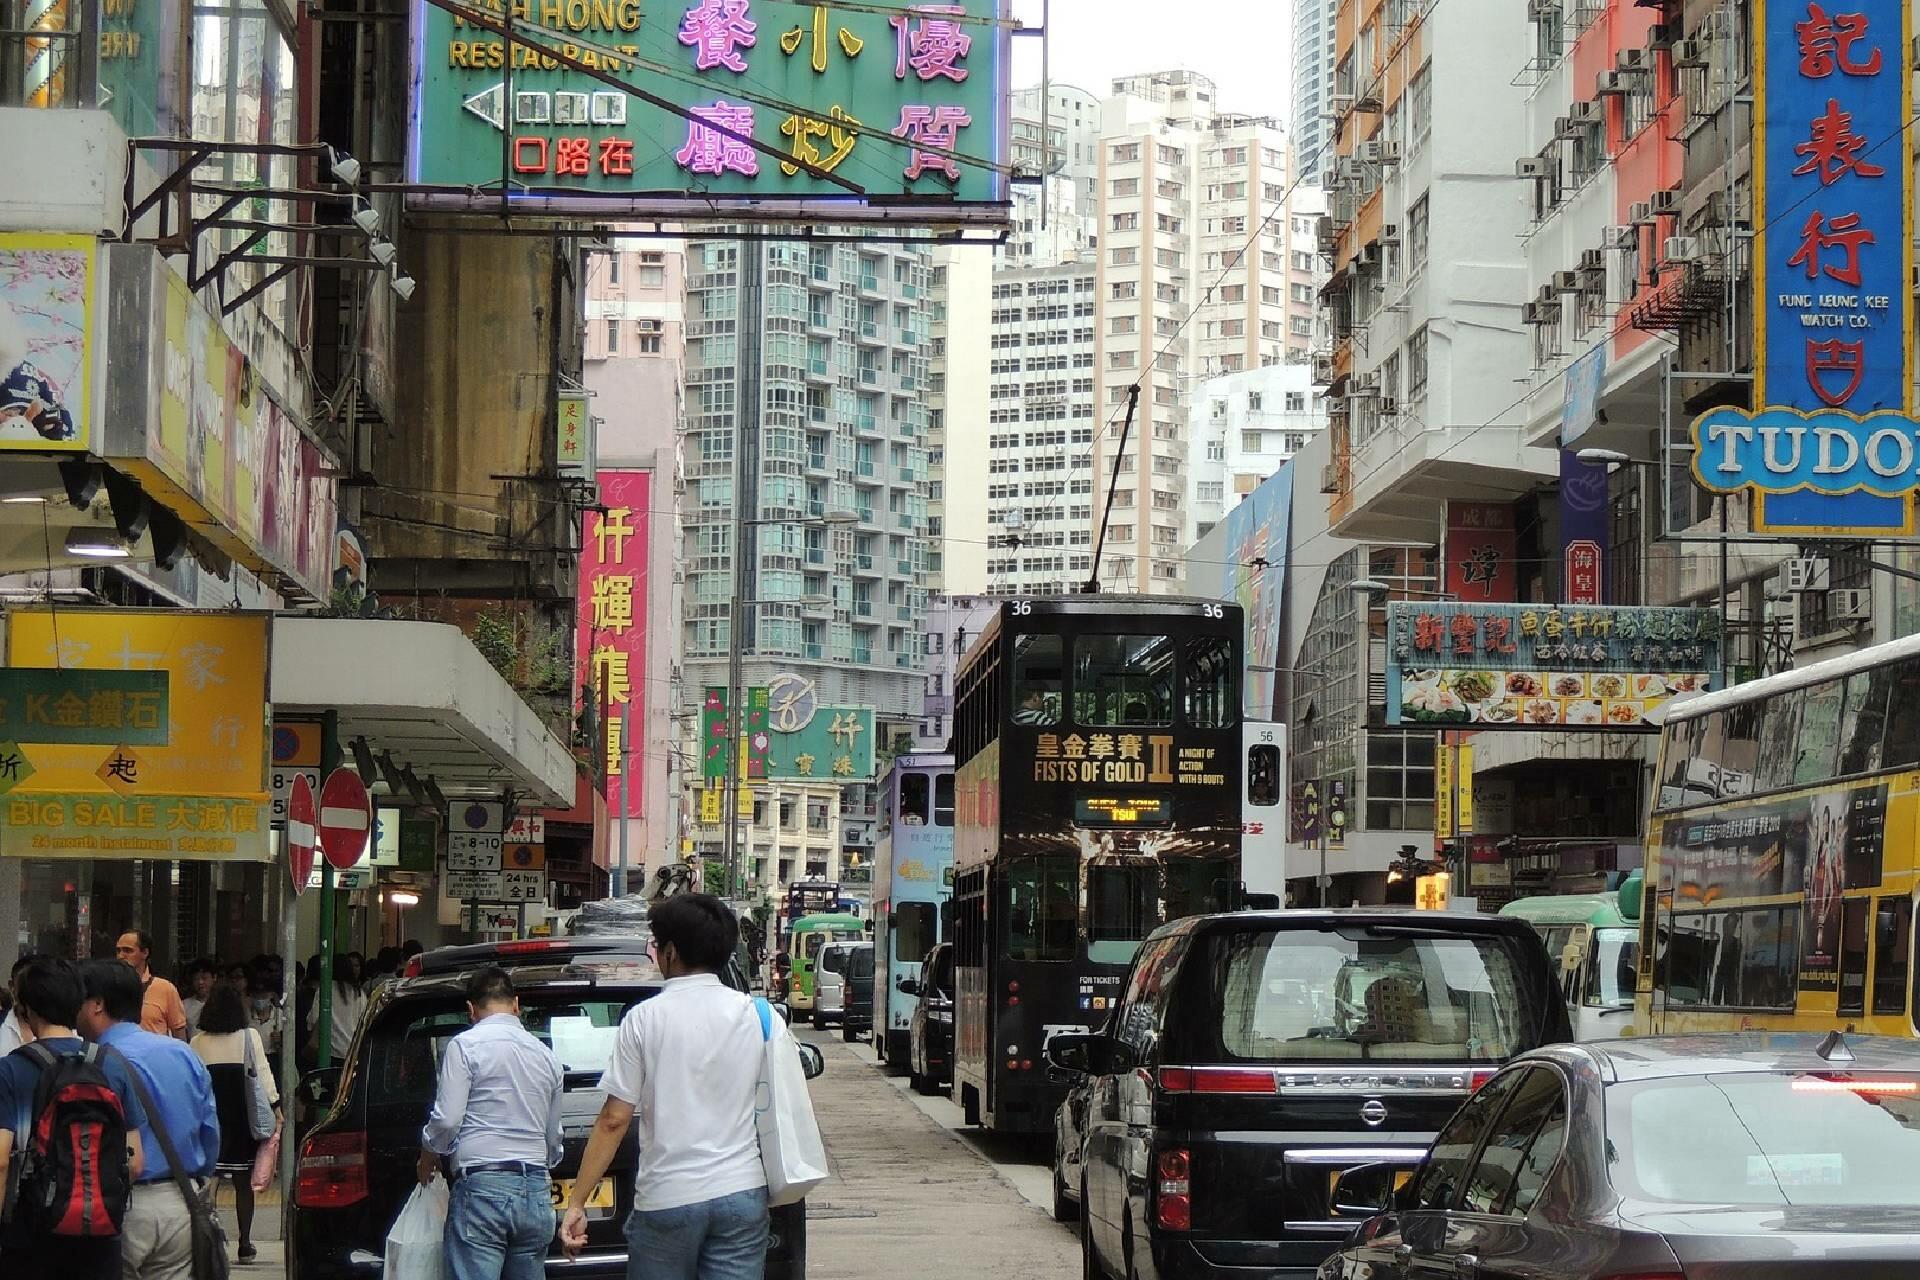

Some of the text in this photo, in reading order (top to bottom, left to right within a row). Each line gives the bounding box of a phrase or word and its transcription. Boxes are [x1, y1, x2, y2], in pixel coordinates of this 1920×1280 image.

[449, 42, 640, 72] RESTAURANT
[1779, 294, 1889, 308] FUNG LEUNG KEE
[1800, 314, 1872, 328] WATCH CO.
[1011, 600, 1031, 616] 36
[1202, 603, 1223, 619] 36
[1260, 731, 1273, 742] 56
[1034, 736, 1173, 783] FISTS OF GOLD II
[1206, 749, 1215, 758] OF
[107, 754, 137, 783] 起
[1179, 762, 1203, 771] ACTION
[10, 802, 63, 826] BIG
[75, 803, 156, 827] SALE
[1111, 809, 1138, 821] TSUI
[469, 837, 499, 849] 8-10
[469, 856, 494, 865] 5-7
[506, 873, 538, 883] 24 hrs
[510, 887, 536, 897] 全日
[1285, 1076, 1464, 1089] ELGRAND
